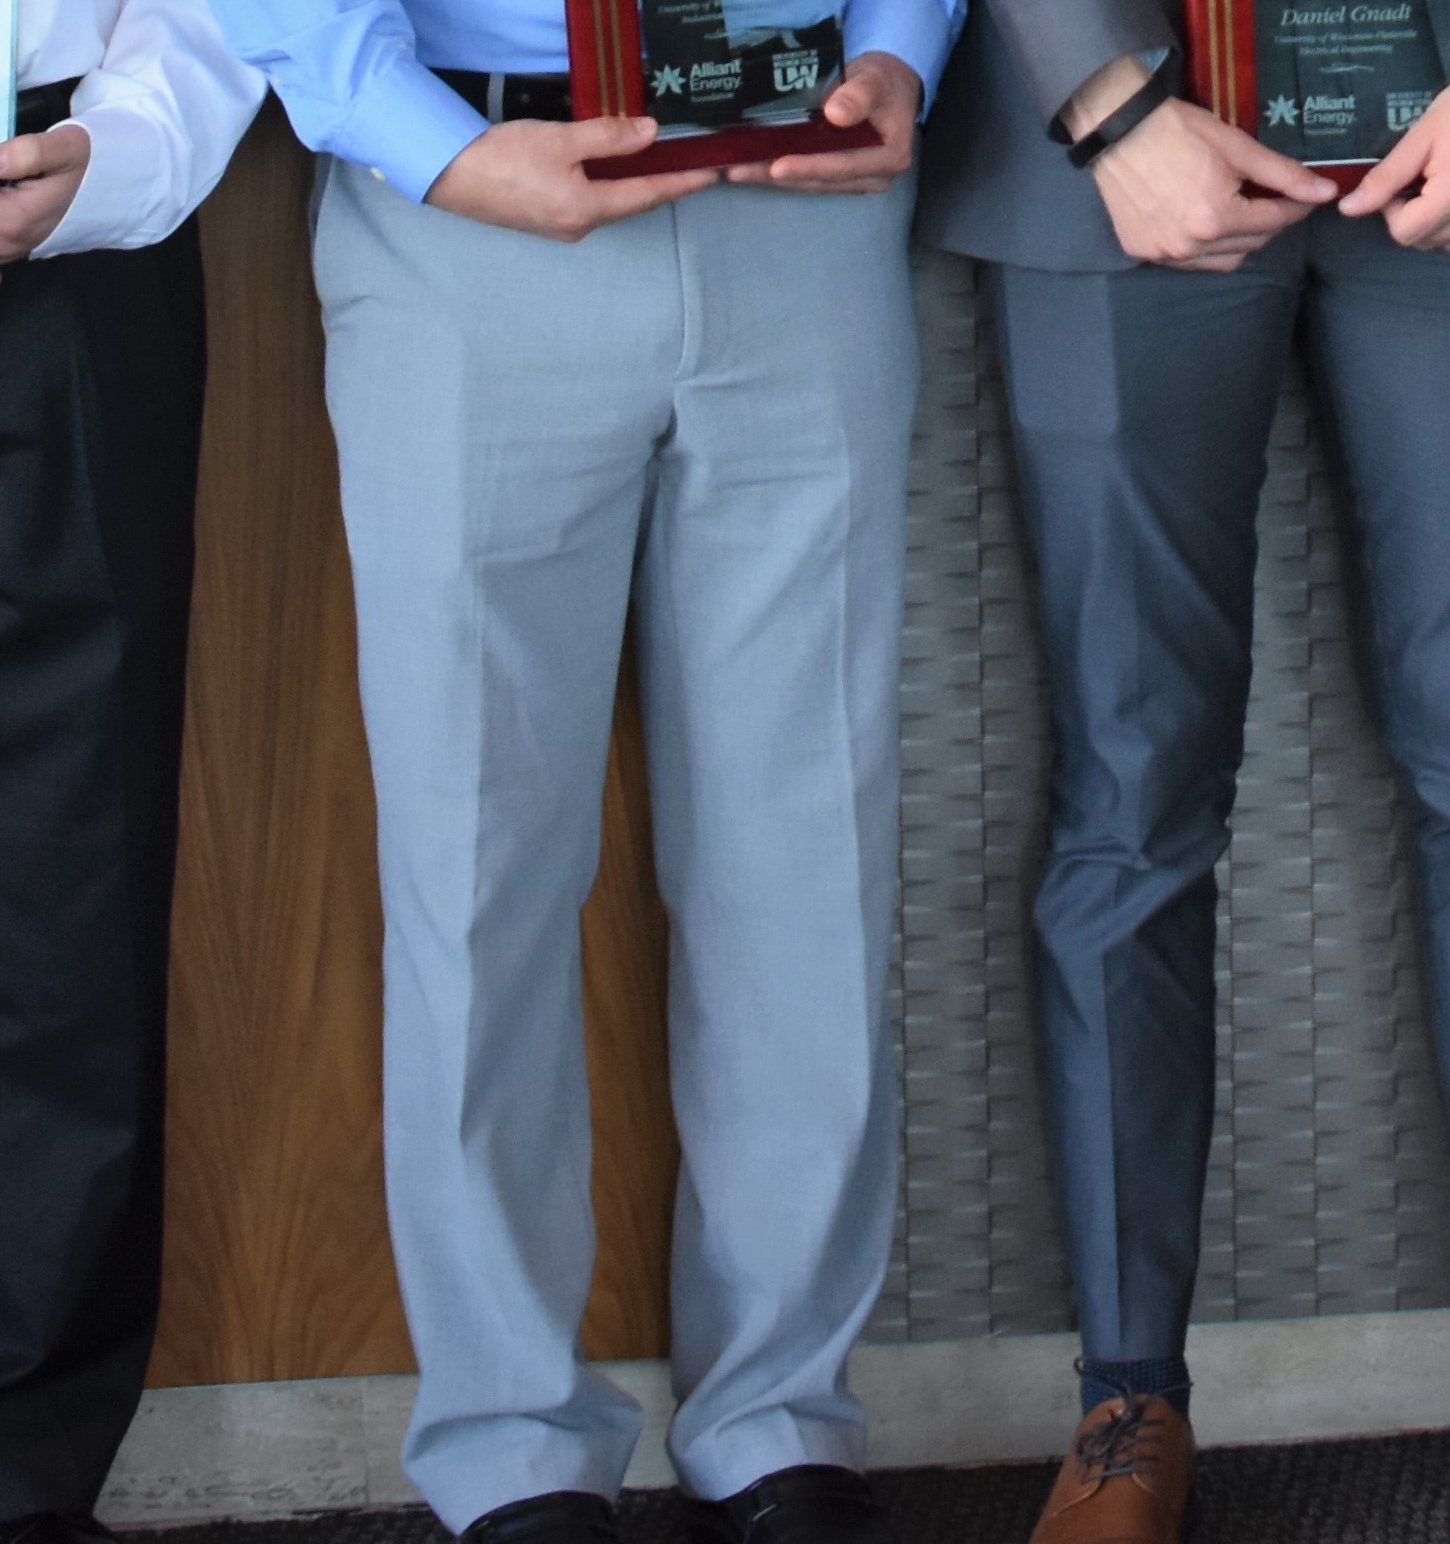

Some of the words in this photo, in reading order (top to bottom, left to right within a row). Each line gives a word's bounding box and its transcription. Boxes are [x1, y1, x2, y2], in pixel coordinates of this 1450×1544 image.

[1281, 5, 1347, 26] Daniel
[1350, 2, 1412, 23] Gnadt
[691, 59, 742, 77] Alliant
[690, 76, 741, 93] Energy
[773, 63, 818, 92] UW
[1305, 94, 1355, 109] Alliant
[1304, 111, 1354, 125] Energy
